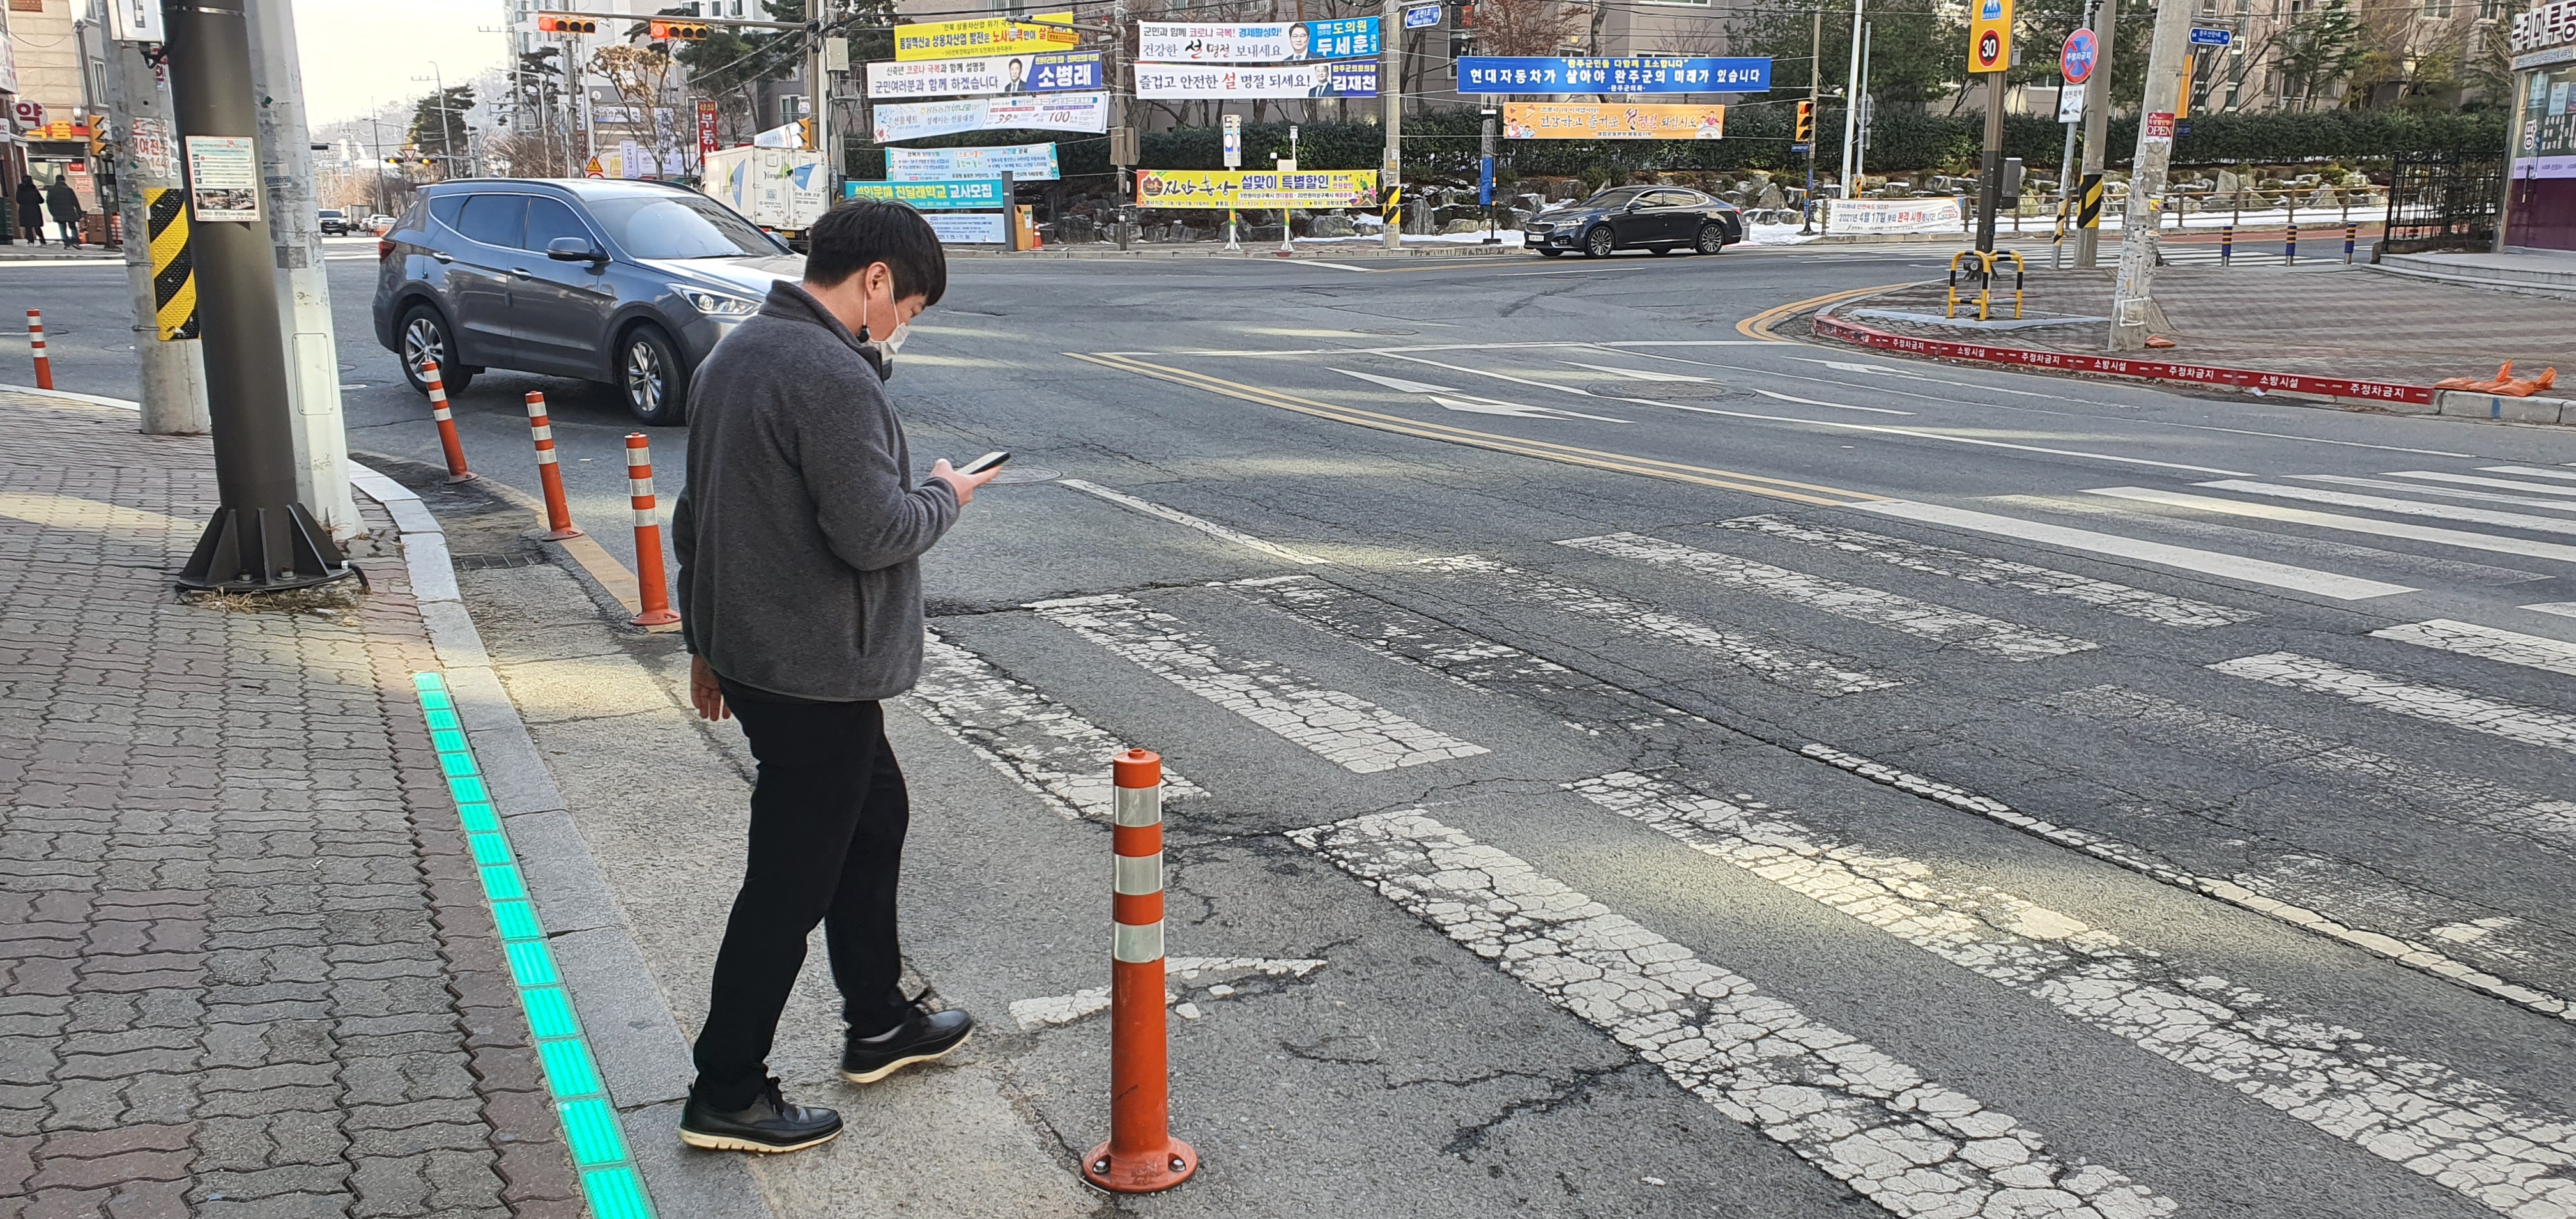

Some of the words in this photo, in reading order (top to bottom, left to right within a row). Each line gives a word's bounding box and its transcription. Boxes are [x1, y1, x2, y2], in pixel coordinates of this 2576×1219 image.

[1144, 27, 1168, 37] 군민과
[1170, 27, 1186, 37] 함께
[1189, 27, 1213, 38] 코로나
[1216, 27, 1235, 38] 극복!
[1239, 27, 1282, 38] 경제활성화!
[1333, 20, 1367, 34] 도의원
[900, 36, 930, 50] 품질혁신과
[932, 33, 967, 48] 상용차산업
[969, 32, 990, 45] 발전은
[993, 29, 1036, 43] 노사력만이
[1317, 34, 1368, 56] 두세훈
[1981, 38, 1997, 57] 30
[1143, 43, 1178, 57] 건강한
[1185, 39, 1202, 59] 설
[1206, 43, 1230, 58] 명절
[1234, 44, 1283, 58] 보내세요
[2066, 51, 2092, 62] 주정차금지
[886, 66, 904, 76] 신축년
[906, 65, 925, 74] 코로나
[927, 63, 947, 73] 극복과
[949, 62, 963, 73] 함께
[965, 62, 986, 72] 설명절
[1614, 59, 1639, 68] 다함께
[1038, 63, 1091, 87] 소병래
[1138, 74, 1177, 89] 즐겁고
[1180, 73, 1218, 89] 안전한
[1222, 72, 1237, 90] 설
[1241, 73, 1266, 89] 명절
[1269, 73, 1310, 89] 되세요!
[1333, 75, 1376, 91] 김재천
[1470, 68, 1557, 84] 현대자동차가
[1565, 69, 1606, 84] 살아야
[1614, 69, 1666, 84] 완주군의
[1674, 69, 1710, 84] 미래가
[1717, 68, 1760, 83] 있습니다
[875, 79, 924, 94] 군민여러분과
[928, 78, 947, 91] 함께
[950, 75, 999, 90] 하겠습니다
[2064, 89, 2083, 99] 견인지역
[15, 102, 43, 127] 약
[1048, 111, 1071, 123] 100
[1540, 115, 1583, 128] 건강하고
[1587, 114, 1619, 129] 즐거운
[1661, 115, 1698, 130] 되십시오
[2147, 125, 2172, 135] OPEN
[1241, 174, 1277, 190] 설맞이
[1282, 174, 1329, 190] 특별할인
[895, 185, 947, 200] 진달래학교
[949, 183, 992, 199] 교사모집
[1839, 213, 1858, 222] 2021년
[1859, 211, 1871, 222] 4월
[1871, 211, 1887, 223] 17일
[1887, 214, 1896, 222] 부터
[1897, 211, 1910, 223] 본격
[1892, 338, 1924, 351] 주정차금지
[1957, 346, 1985, 358] 소방시설
[2021, 352, 2060, 365] 주정차금지
[2094, 359, 2127, 371] 소방시설
[2168, 365, 2214, 380] 주정차금지
[2259, 374, 2299, 388] 소방시설
[2349, 383, 2405, 399] 주정차금지
